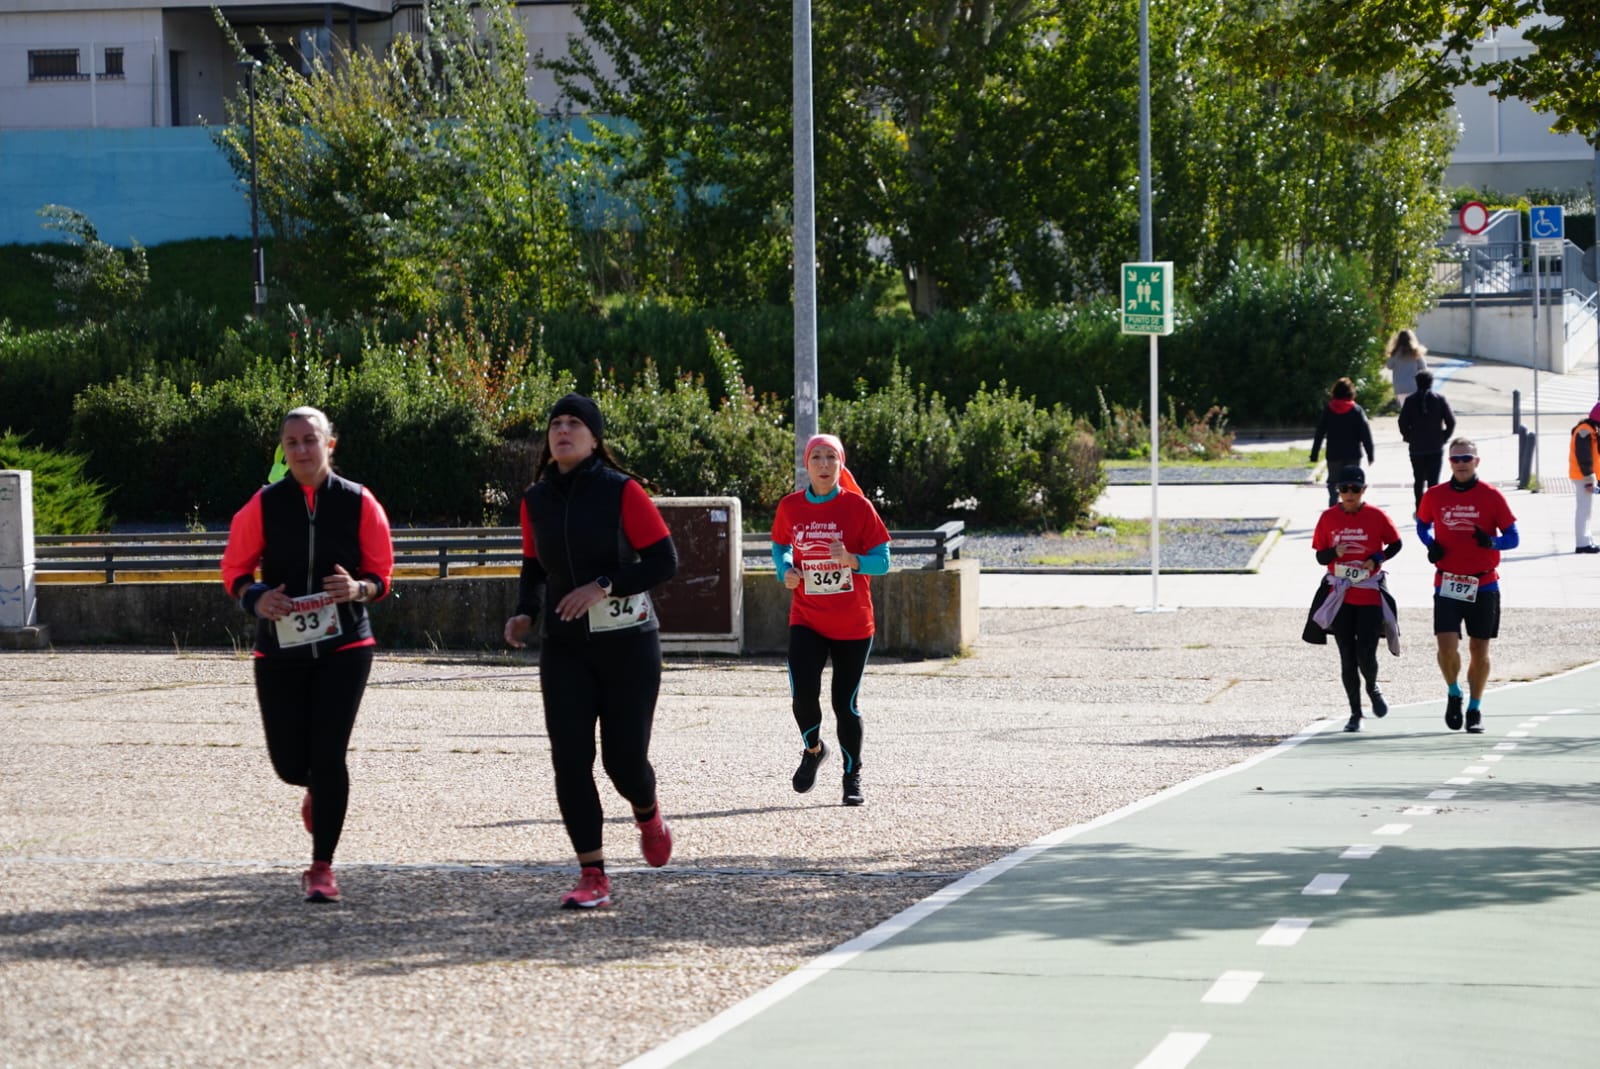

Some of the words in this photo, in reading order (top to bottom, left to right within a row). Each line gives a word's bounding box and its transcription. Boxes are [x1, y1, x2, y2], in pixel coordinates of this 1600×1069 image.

[1128, 316, 1150, 324] PUNTO
[813, 571, 842, 586] 349
[1345, 567, 1359, 578] 60
[1450, 582, 1472, 594] 187
[609, 598, 633, 617] 34
[294, 612, 319, 632] 33
